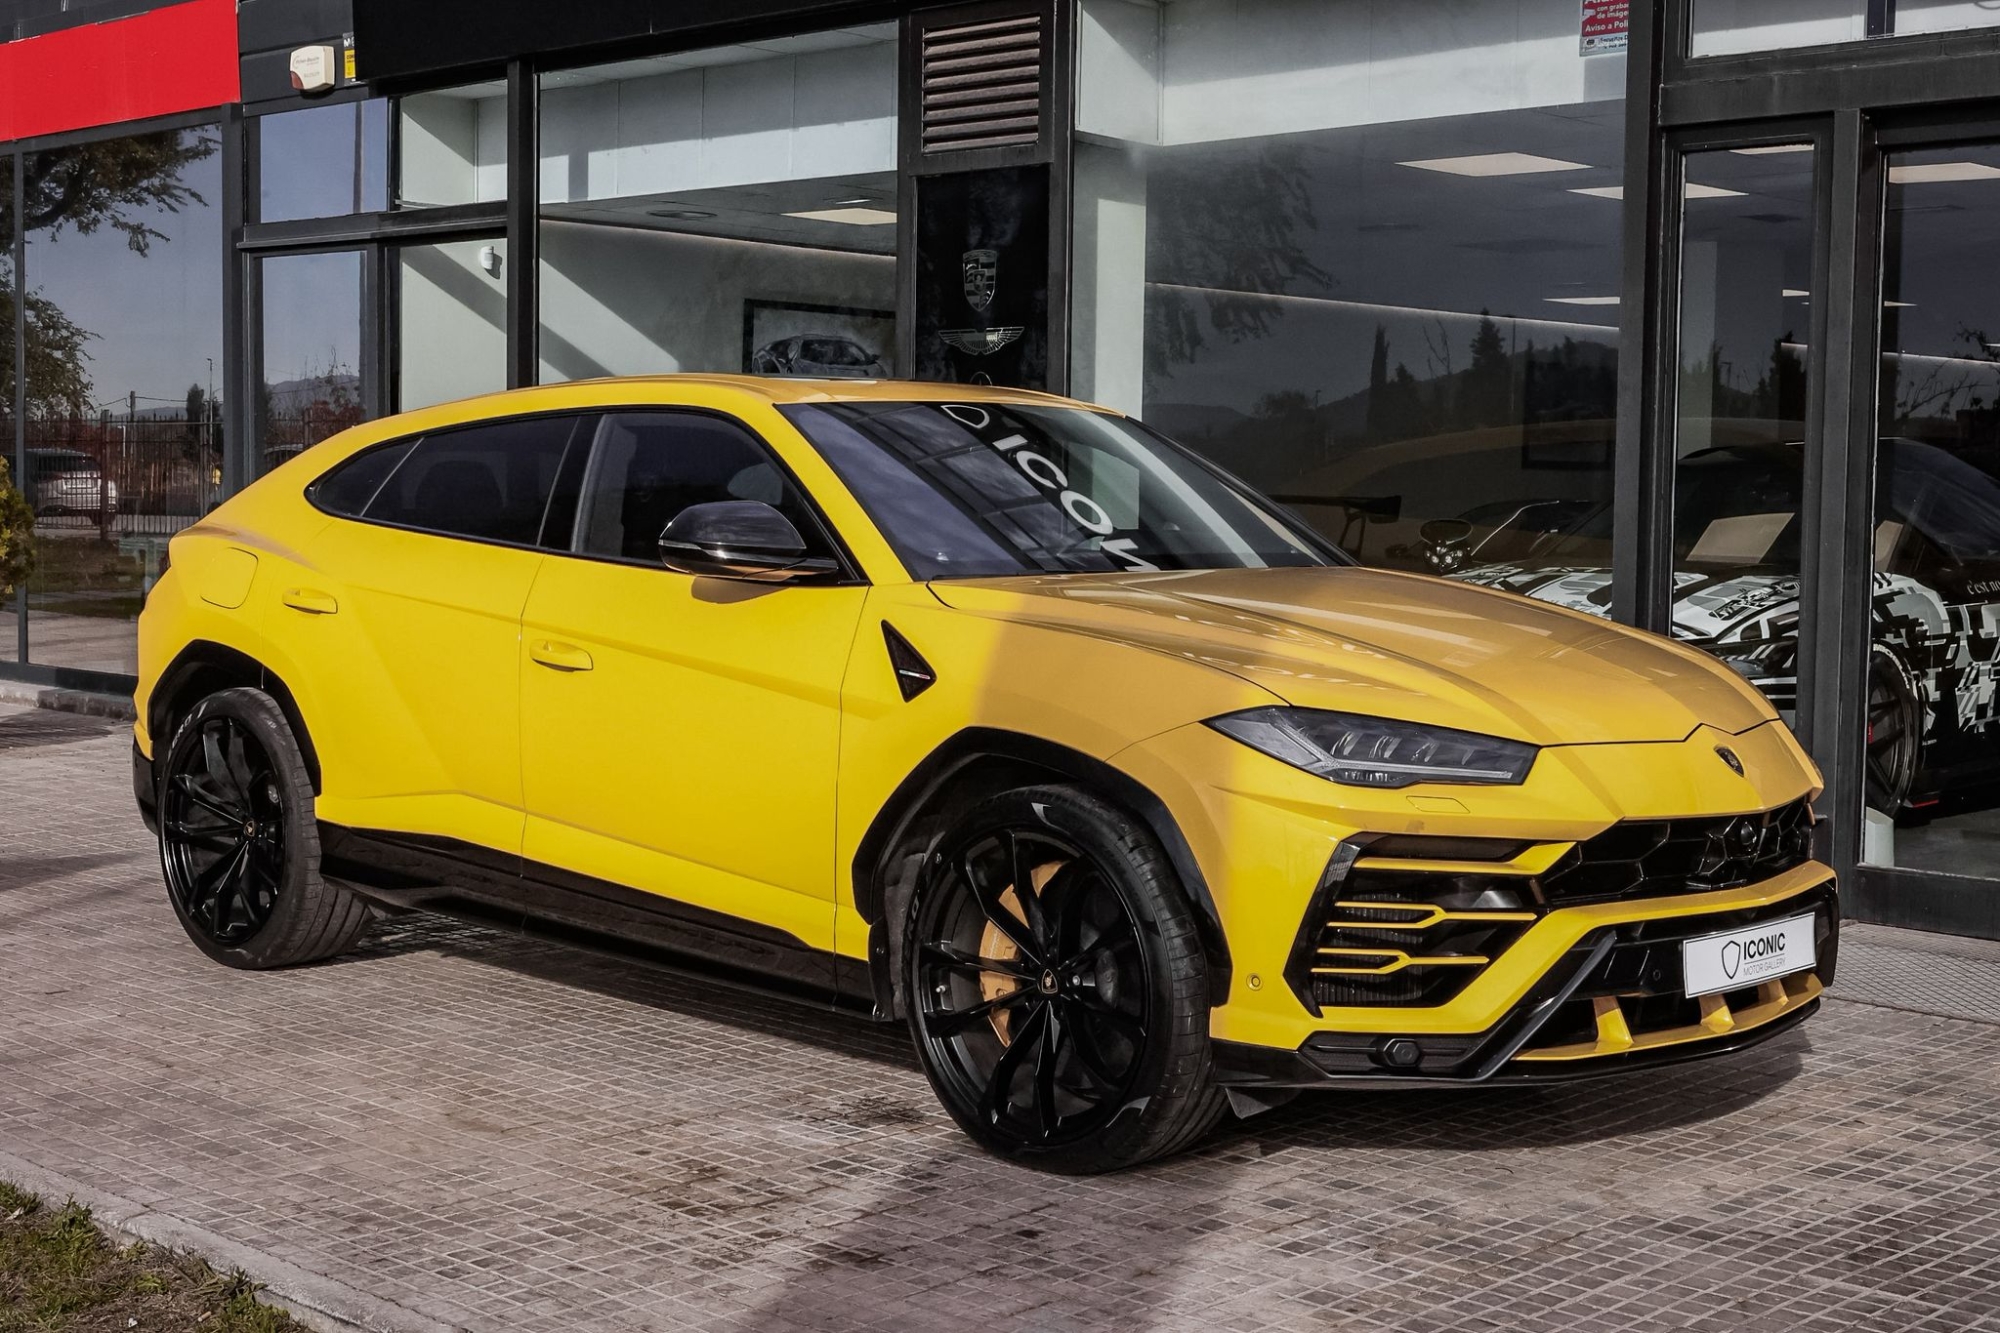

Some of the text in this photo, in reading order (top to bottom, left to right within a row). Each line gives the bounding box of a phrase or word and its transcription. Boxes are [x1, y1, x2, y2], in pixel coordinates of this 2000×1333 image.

[1743, 932, 1786, 960] ICONIC
[1743, 957, 1786, 976] MOTOR GALLERY
